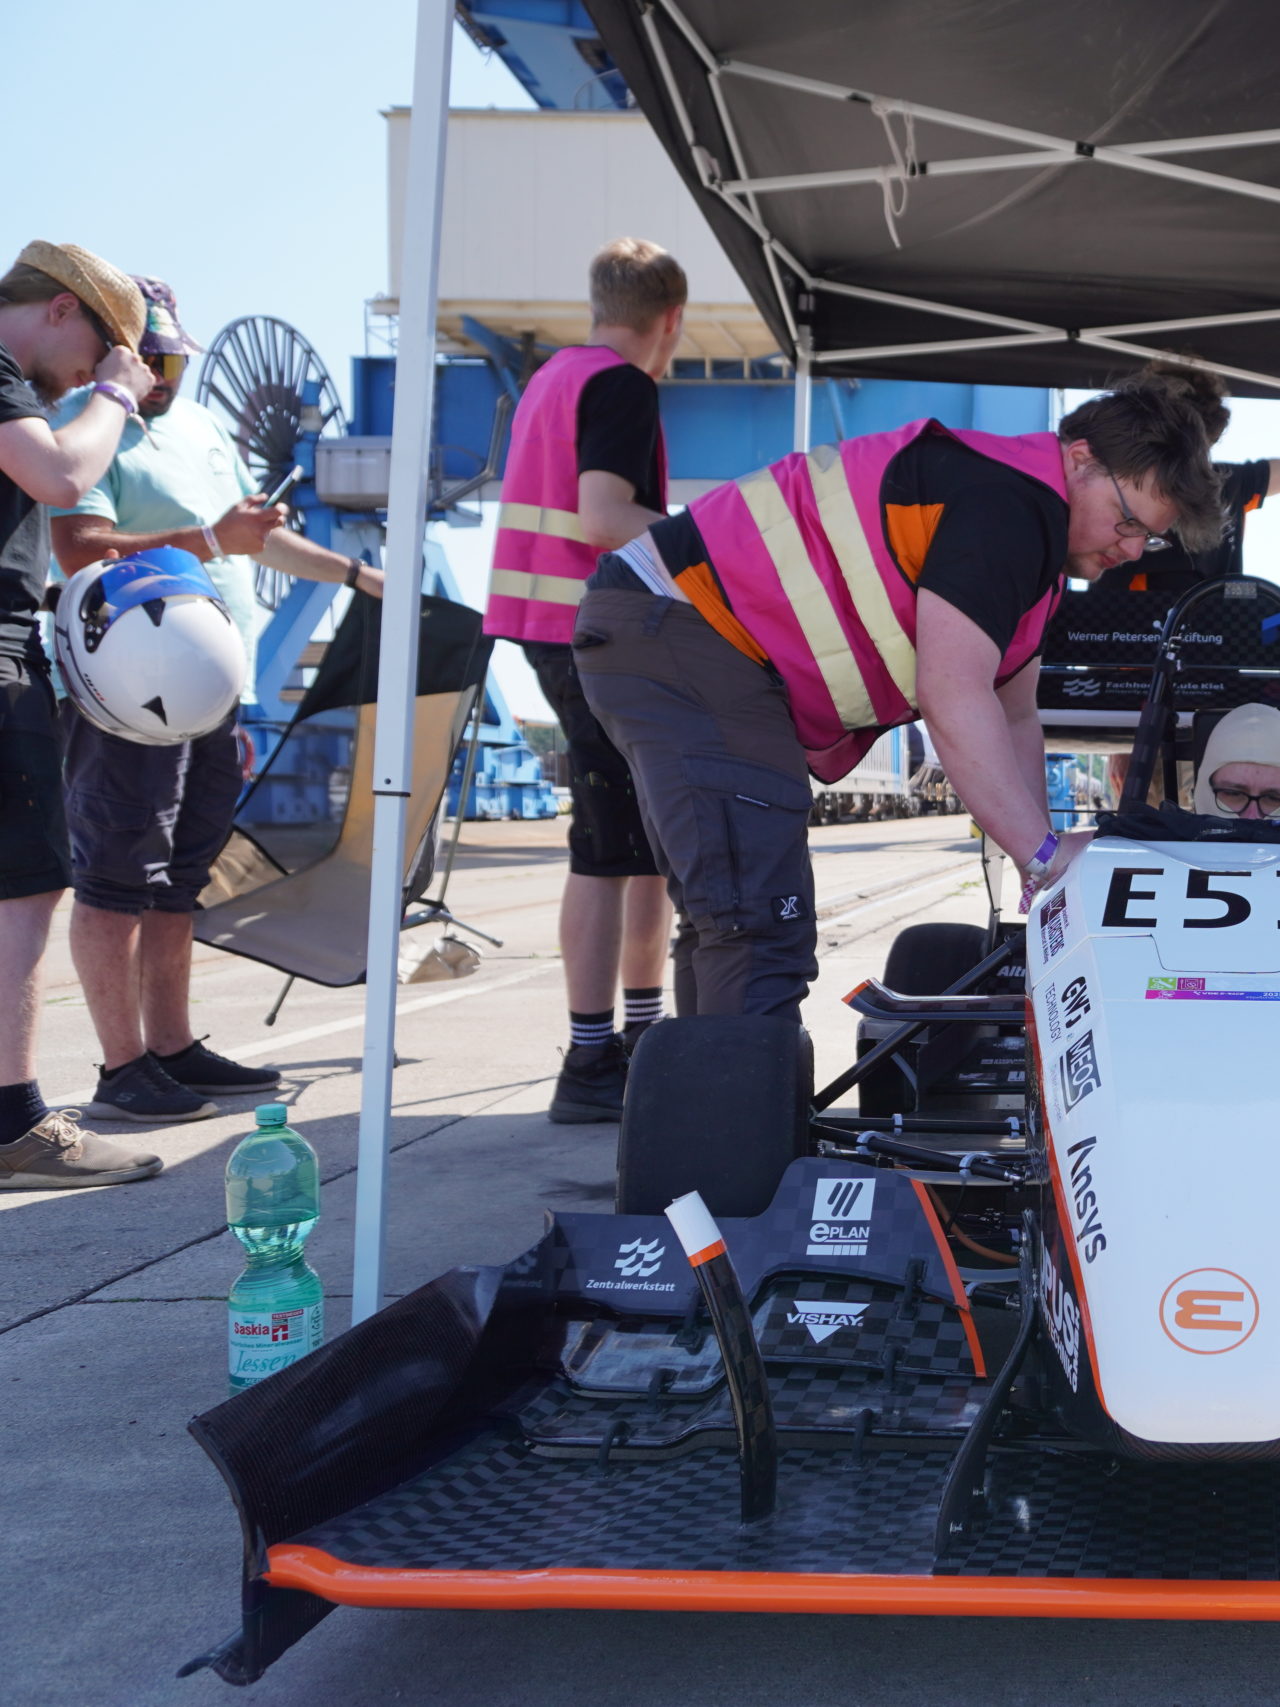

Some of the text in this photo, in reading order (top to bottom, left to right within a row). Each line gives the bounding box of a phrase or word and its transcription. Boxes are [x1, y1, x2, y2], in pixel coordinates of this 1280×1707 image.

[1067, 631, 1223, 645] Werner Petersen tiftung
[1061, 976, 1091, 1029] GWJ
[1045, 982, 1062, 1043] TECHNOLOGY
[1067, 1136, 1107, 1264] Ansys
[586, 1279, 675, 1292] Zentralwerkstatt
[786, 1312, 864, 1327] VISHAY
[234, 1322, 270, 1335] Saskia
